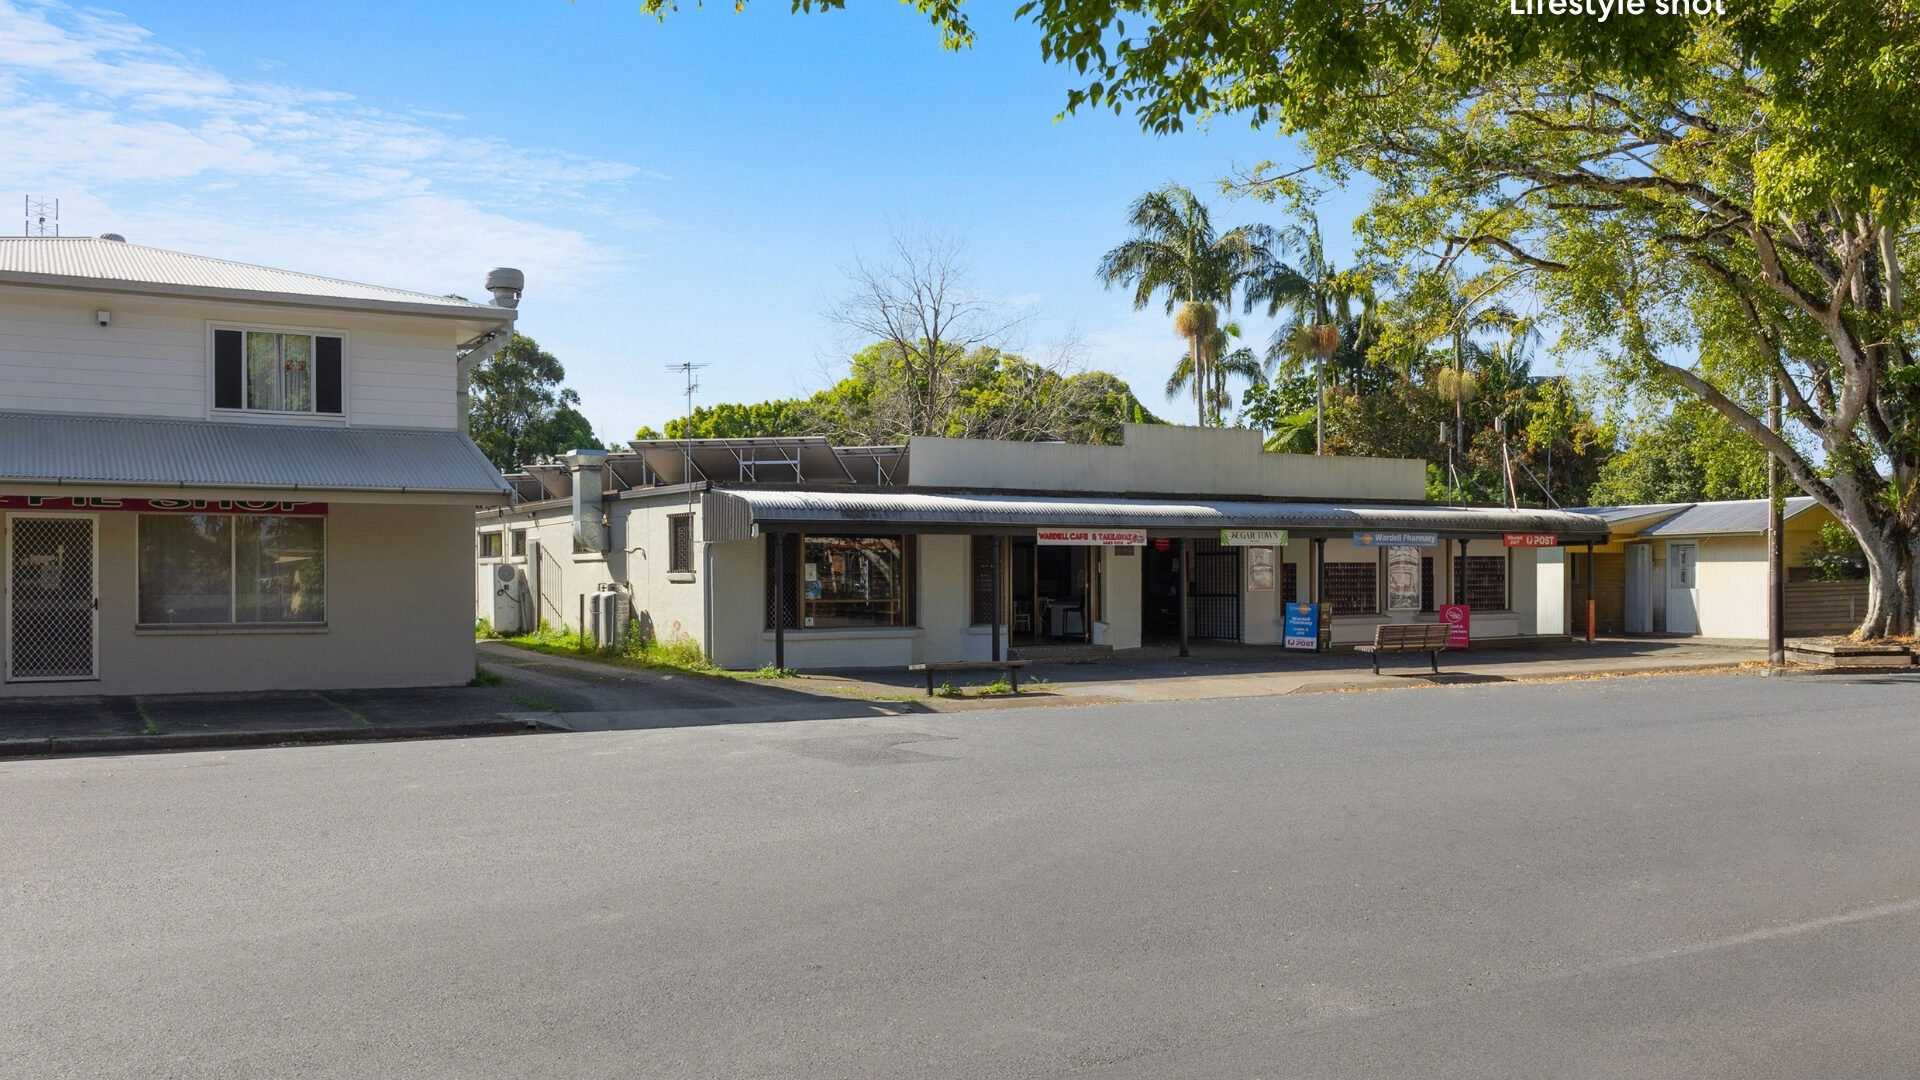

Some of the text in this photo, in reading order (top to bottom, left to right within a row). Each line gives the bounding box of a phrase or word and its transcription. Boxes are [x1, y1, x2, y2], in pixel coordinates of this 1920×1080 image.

[1070, 532, 1089, 541] CAFE
[1231, 531, 1278, 540] SUGAR TOWN
[1375, 533, 1402, 541] Wardell
[1402, 533, 1436, 543] Pharmacy
[1534, 535, 1555, 545] POST
